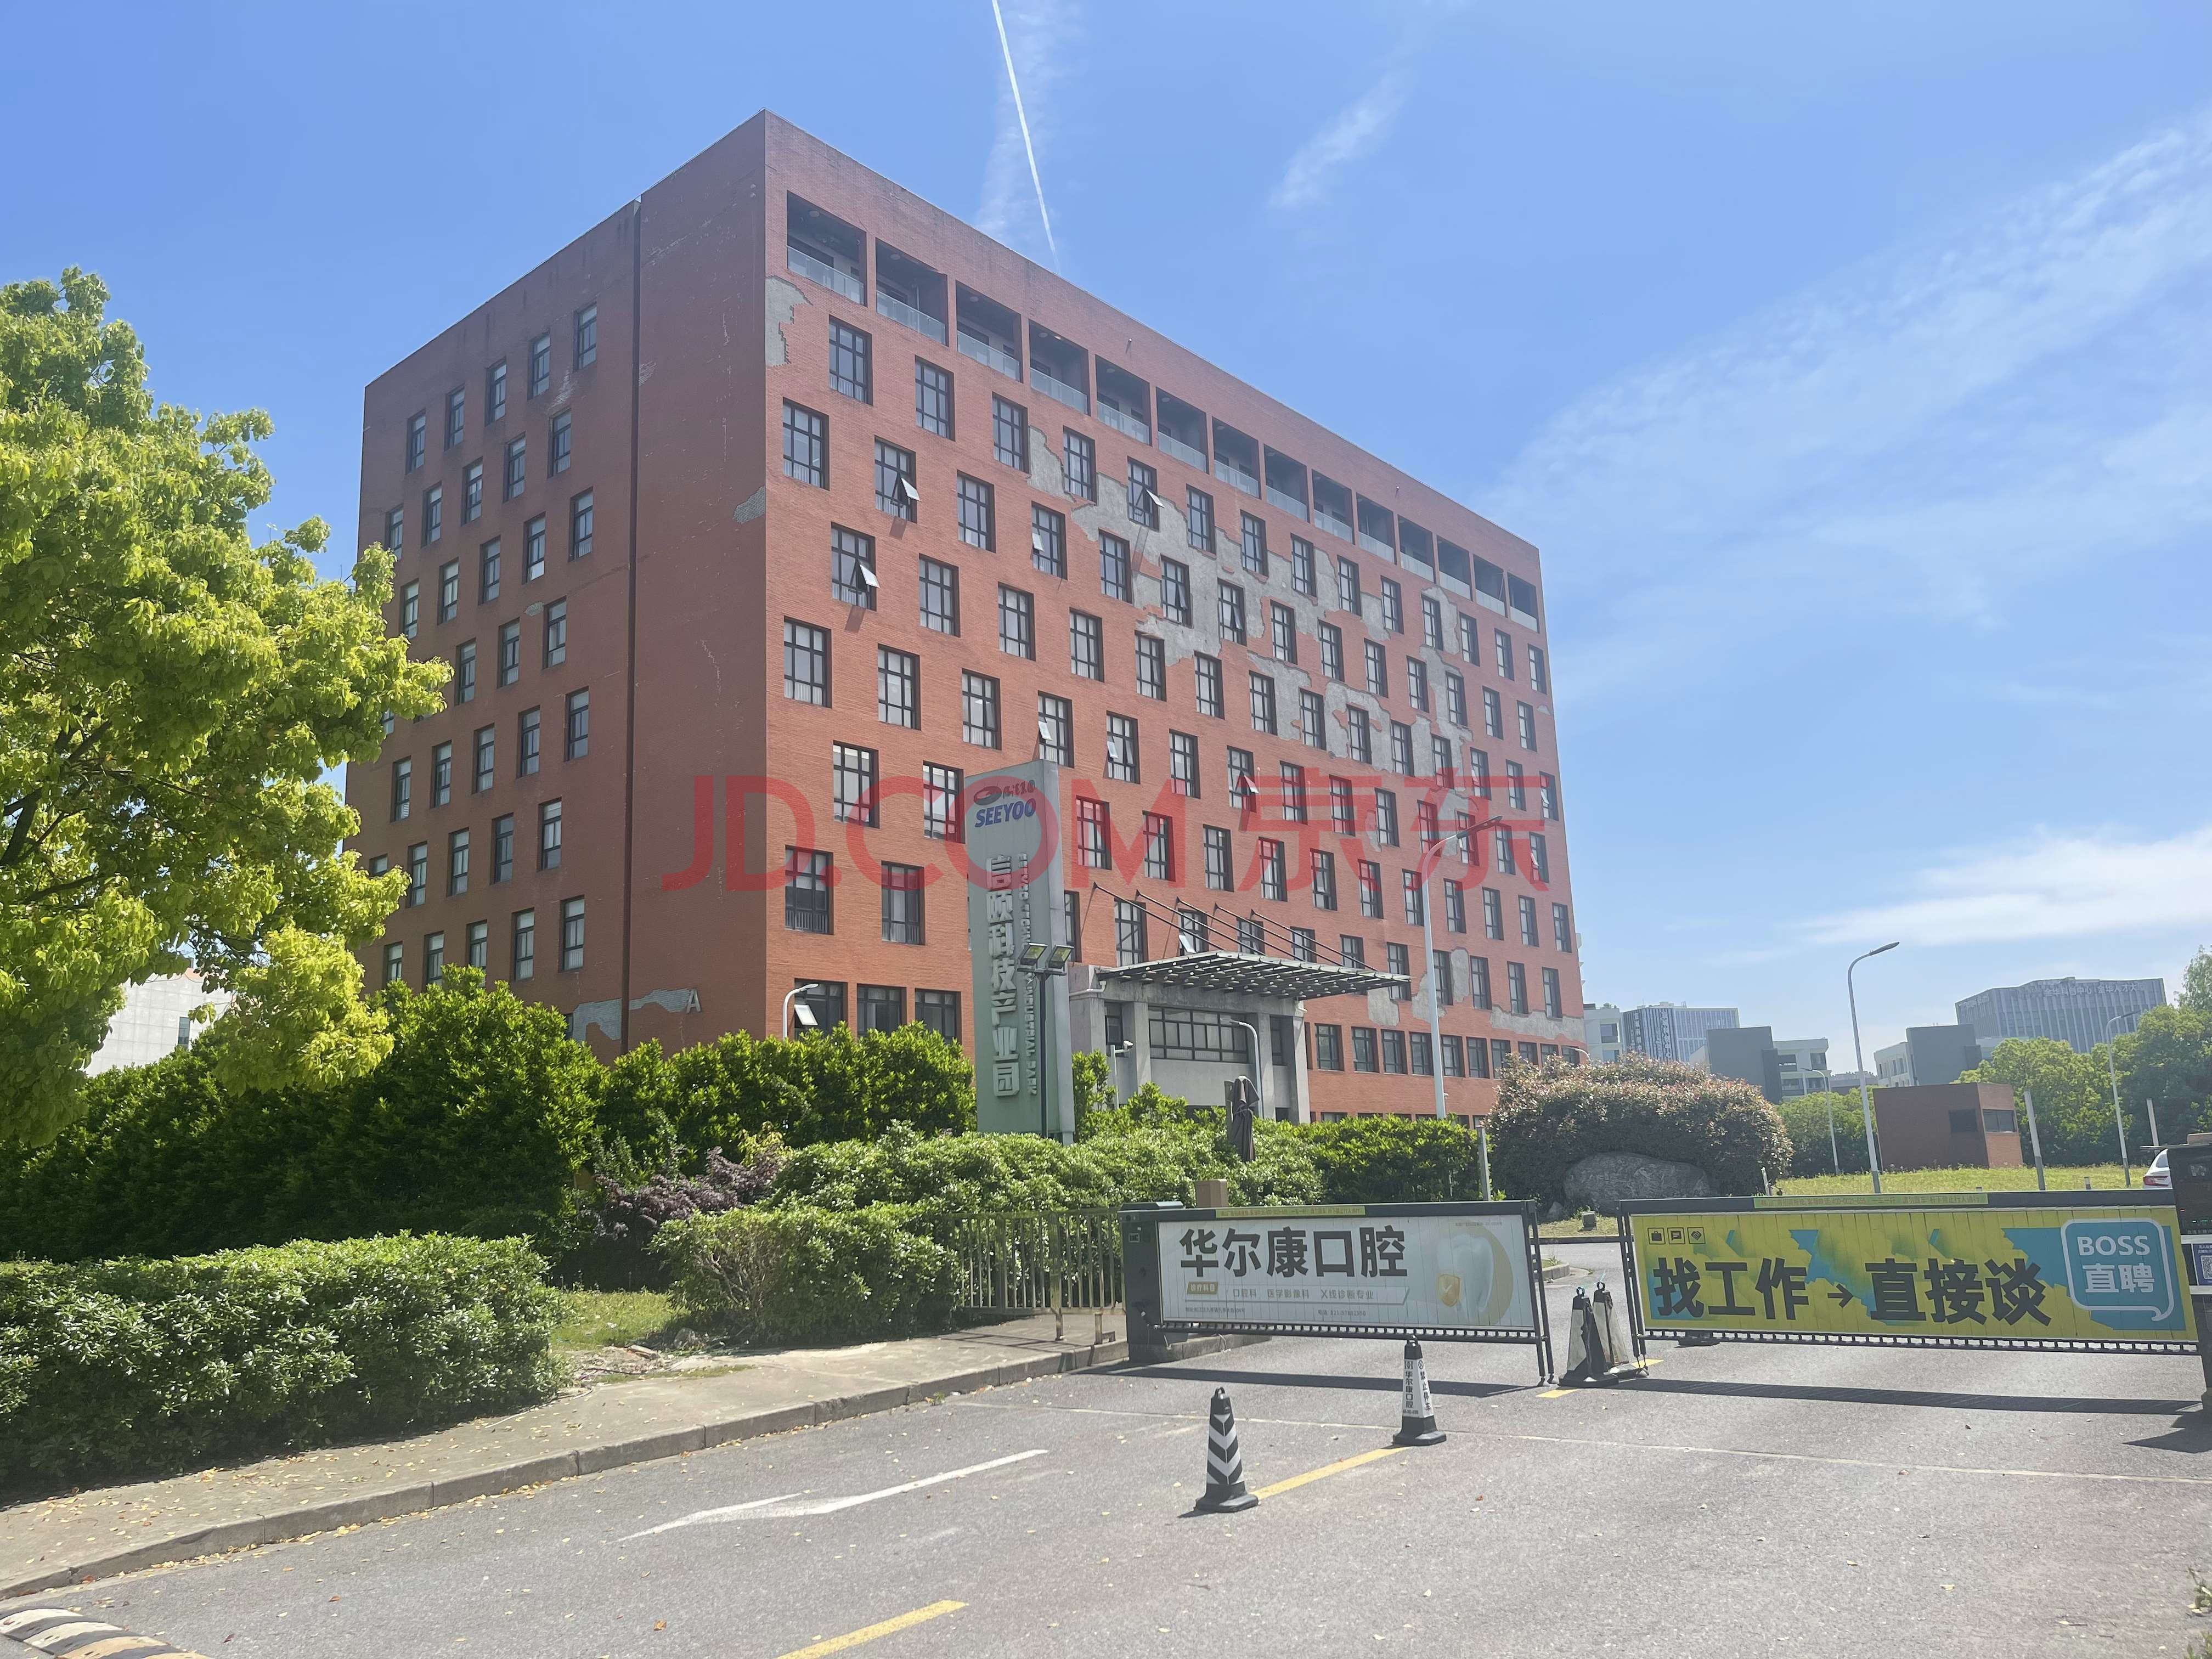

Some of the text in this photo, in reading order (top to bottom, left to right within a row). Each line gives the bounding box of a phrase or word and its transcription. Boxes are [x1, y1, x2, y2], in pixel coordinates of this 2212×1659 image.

[974, 798, 1036, 828] SEEYOO
[686, 988, 701, 1013] A
[1026, 1060, 1038, 1095] PARK
[1180, 1225, 1408, 1278] 华尔康口腔
[2077, 1235, 2150, 1256] BOSS
[1653, 1256, 2051, 1326] 找工作 直接谈
[2083, 1263, 2155, 1293] 直聘
[1233, 1289, 1374, 1300] 口腔科 医学影像科 X线诊断专业
